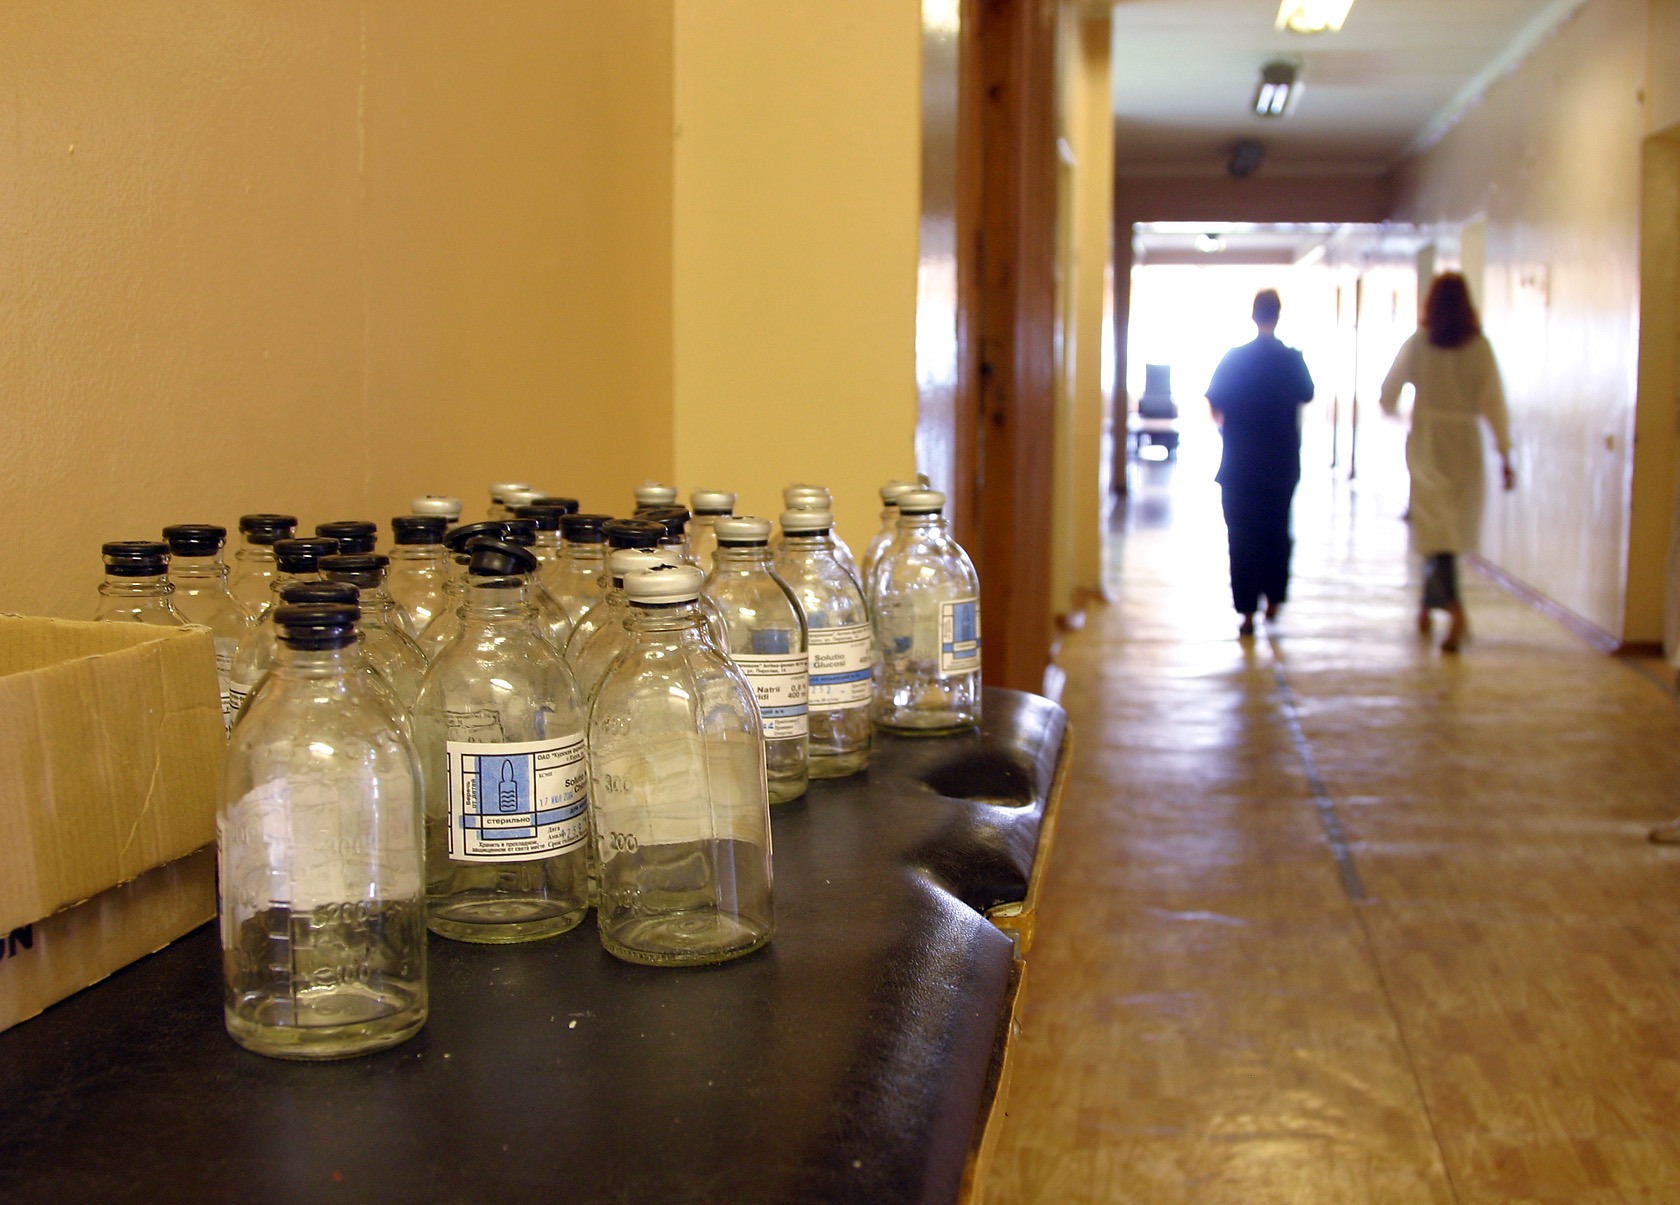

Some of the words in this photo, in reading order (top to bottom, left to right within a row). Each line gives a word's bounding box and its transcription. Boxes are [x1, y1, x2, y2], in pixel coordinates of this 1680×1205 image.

[814, 653, 845, 662] Solutio
[813, 660, 846, 669] Glucosi
[537, 753, 551, 761] ОАО
[486, 816, 531, 825] стерильно
